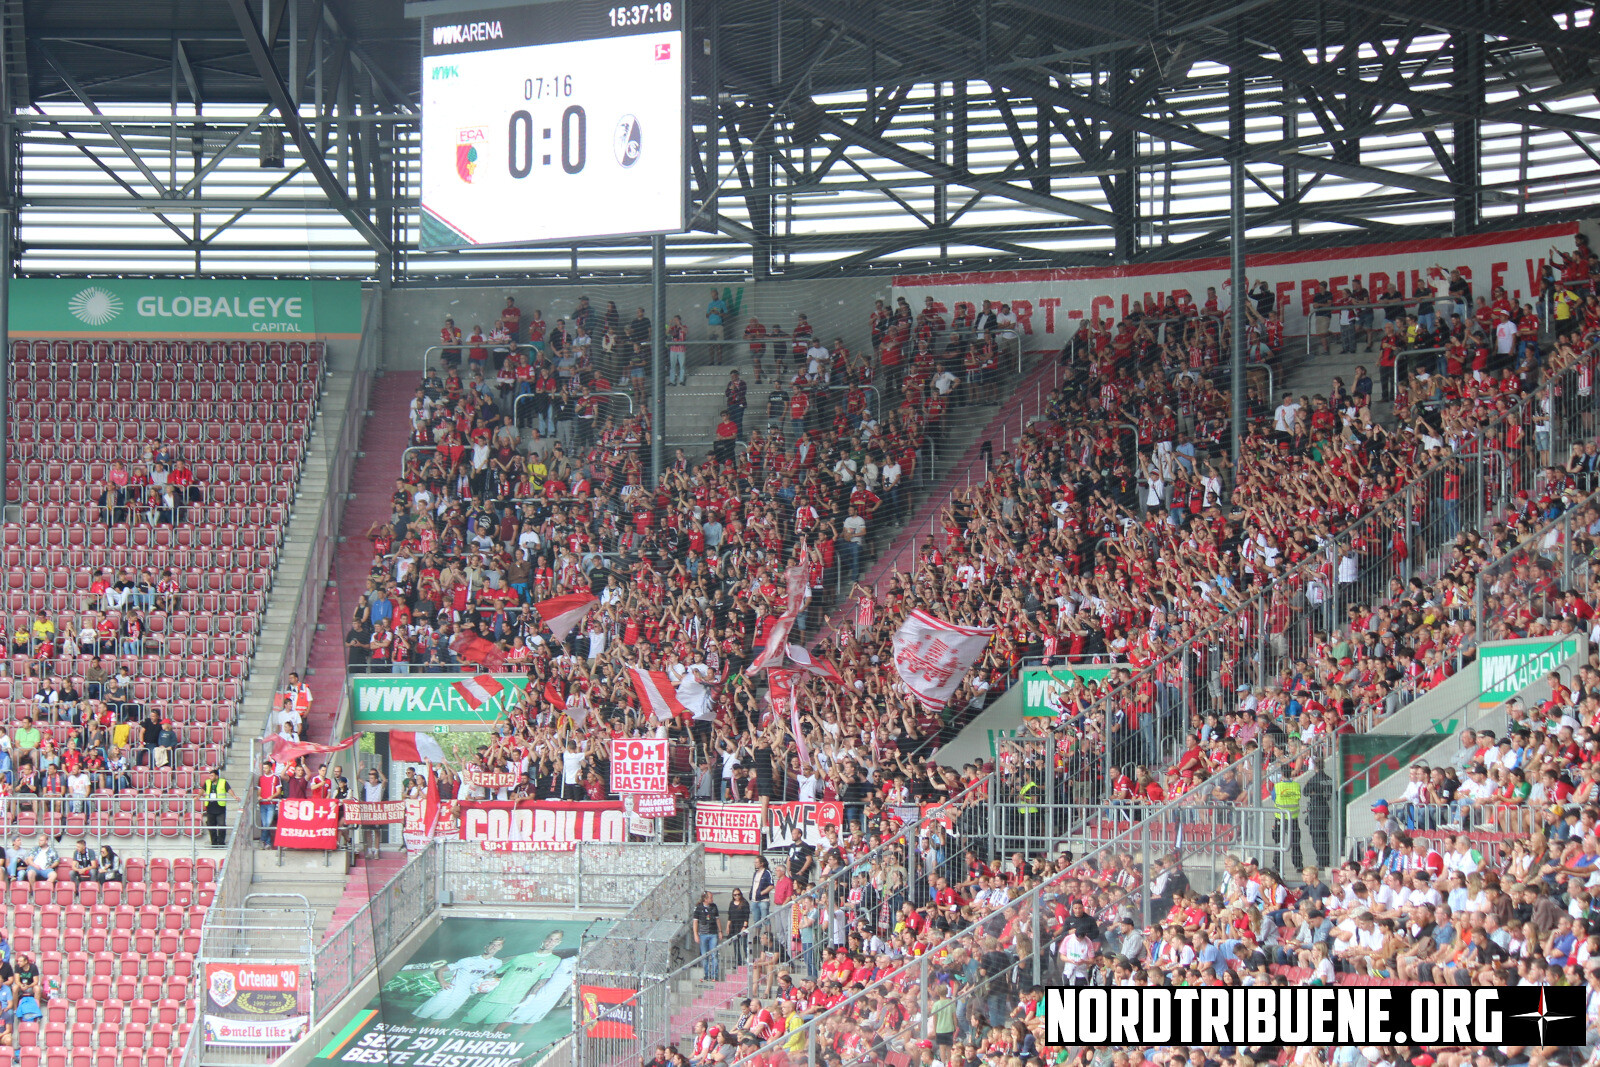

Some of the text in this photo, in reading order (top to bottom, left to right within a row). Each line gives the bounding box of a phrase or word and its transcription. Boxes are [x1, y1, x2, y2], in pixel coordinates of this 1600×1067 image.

[608, 2, 672, 27] 15:37:18
[432, 65, 459, 80] WWK
[524, 74, 573, 100] 07:16
[508, 105, 587, 179] 0:0
[136, 295, 302, 318] GLOBALEYE
[252, 322, 302, 333] CAPITAL
[359, 686, 524, 712] WWKARNA
[614, 742, 665, 761] 50+1
[614, 762, 666, 776] BLEIBT.
[614, 776, 665, 790] BASTA!
[345, 801, 405, 812] FUSSBALL MUSS
[388, 810, 404, 819] SEIN
[466, 809, 623, 841] CORRILLO
[697, 811, 758, 828] SYNTHESIA
[280, 827, 336, 837] ERHALTEN
[699, 829, 757, 843] ULTRAS 79
[484, 841, 508, 850] 50+1
[239, 969, 278, 987] Ortenau
[220, 1026, 286, 1037] Smells like
[373, 1023, 511, 1039] 50 Jahre WWK FondsPolice
[357, 1033, 524, 1056] SEIT 50 JAHREN
[341, 1047, 415, 1065] BESTE
